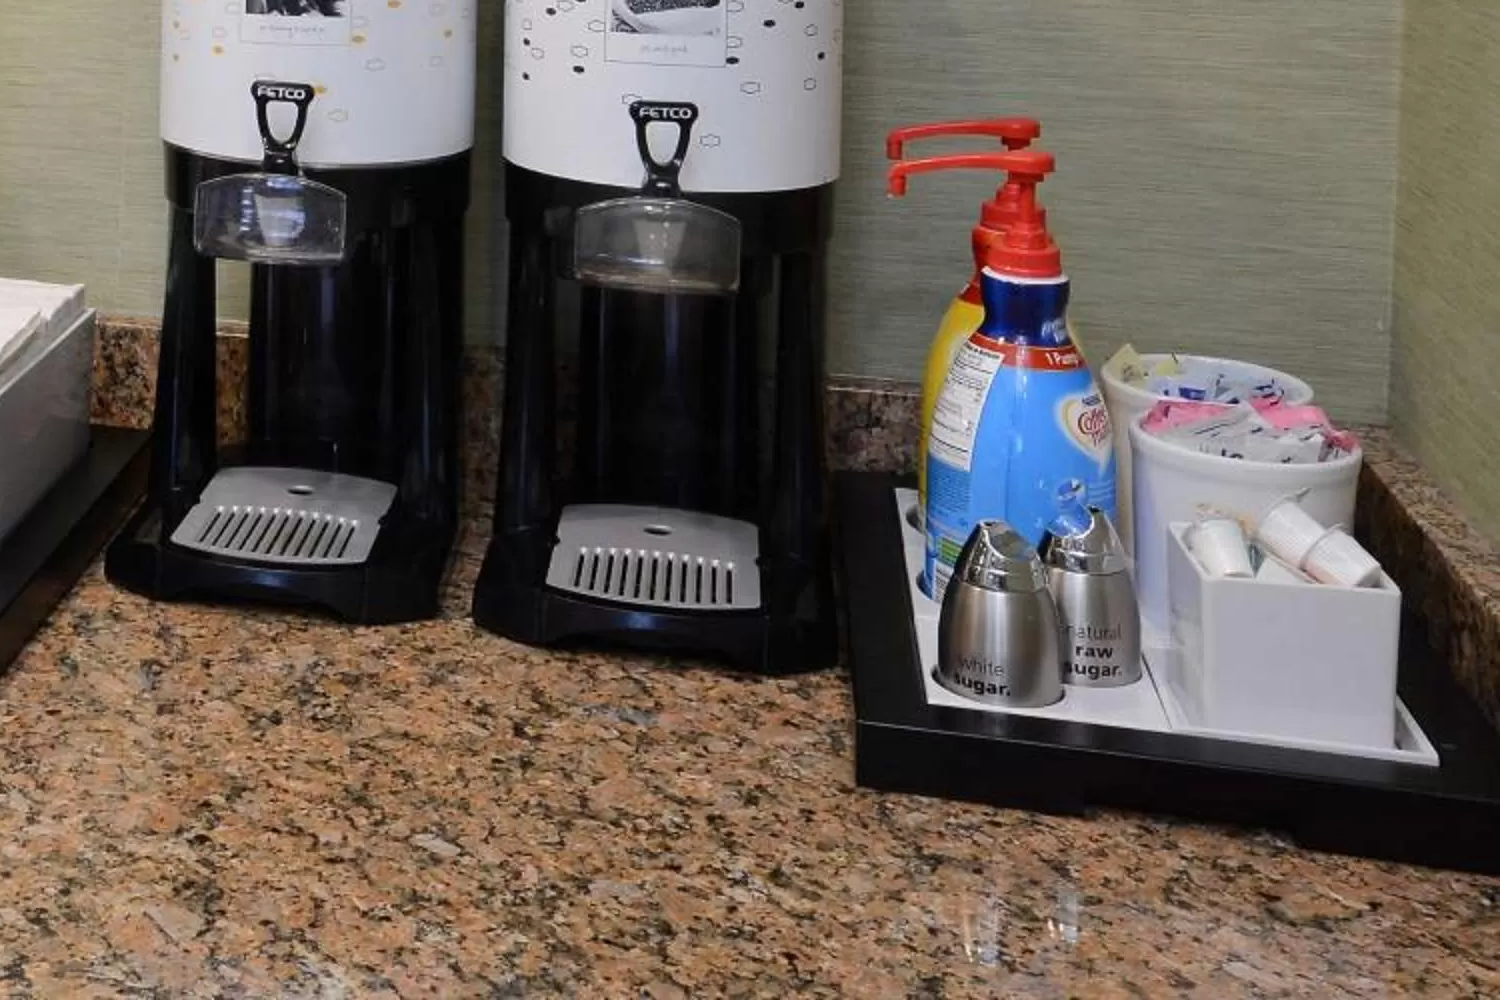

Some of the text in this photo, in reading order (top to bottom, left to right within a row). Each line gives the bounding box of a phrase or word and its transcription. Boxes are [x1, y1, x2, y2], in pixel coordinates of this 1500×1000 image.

[257, 85, 306, 99] FETCO
[639, 105, 692, 119] FETCO
[1059, 623, 1121, 641] natural
[1075, 645, 1114, 659] raw
[960, 657, 1004, 677] white
[1063, 661, 1122, 681] sugar.
[954, 671, 1011, 697] sugar.
